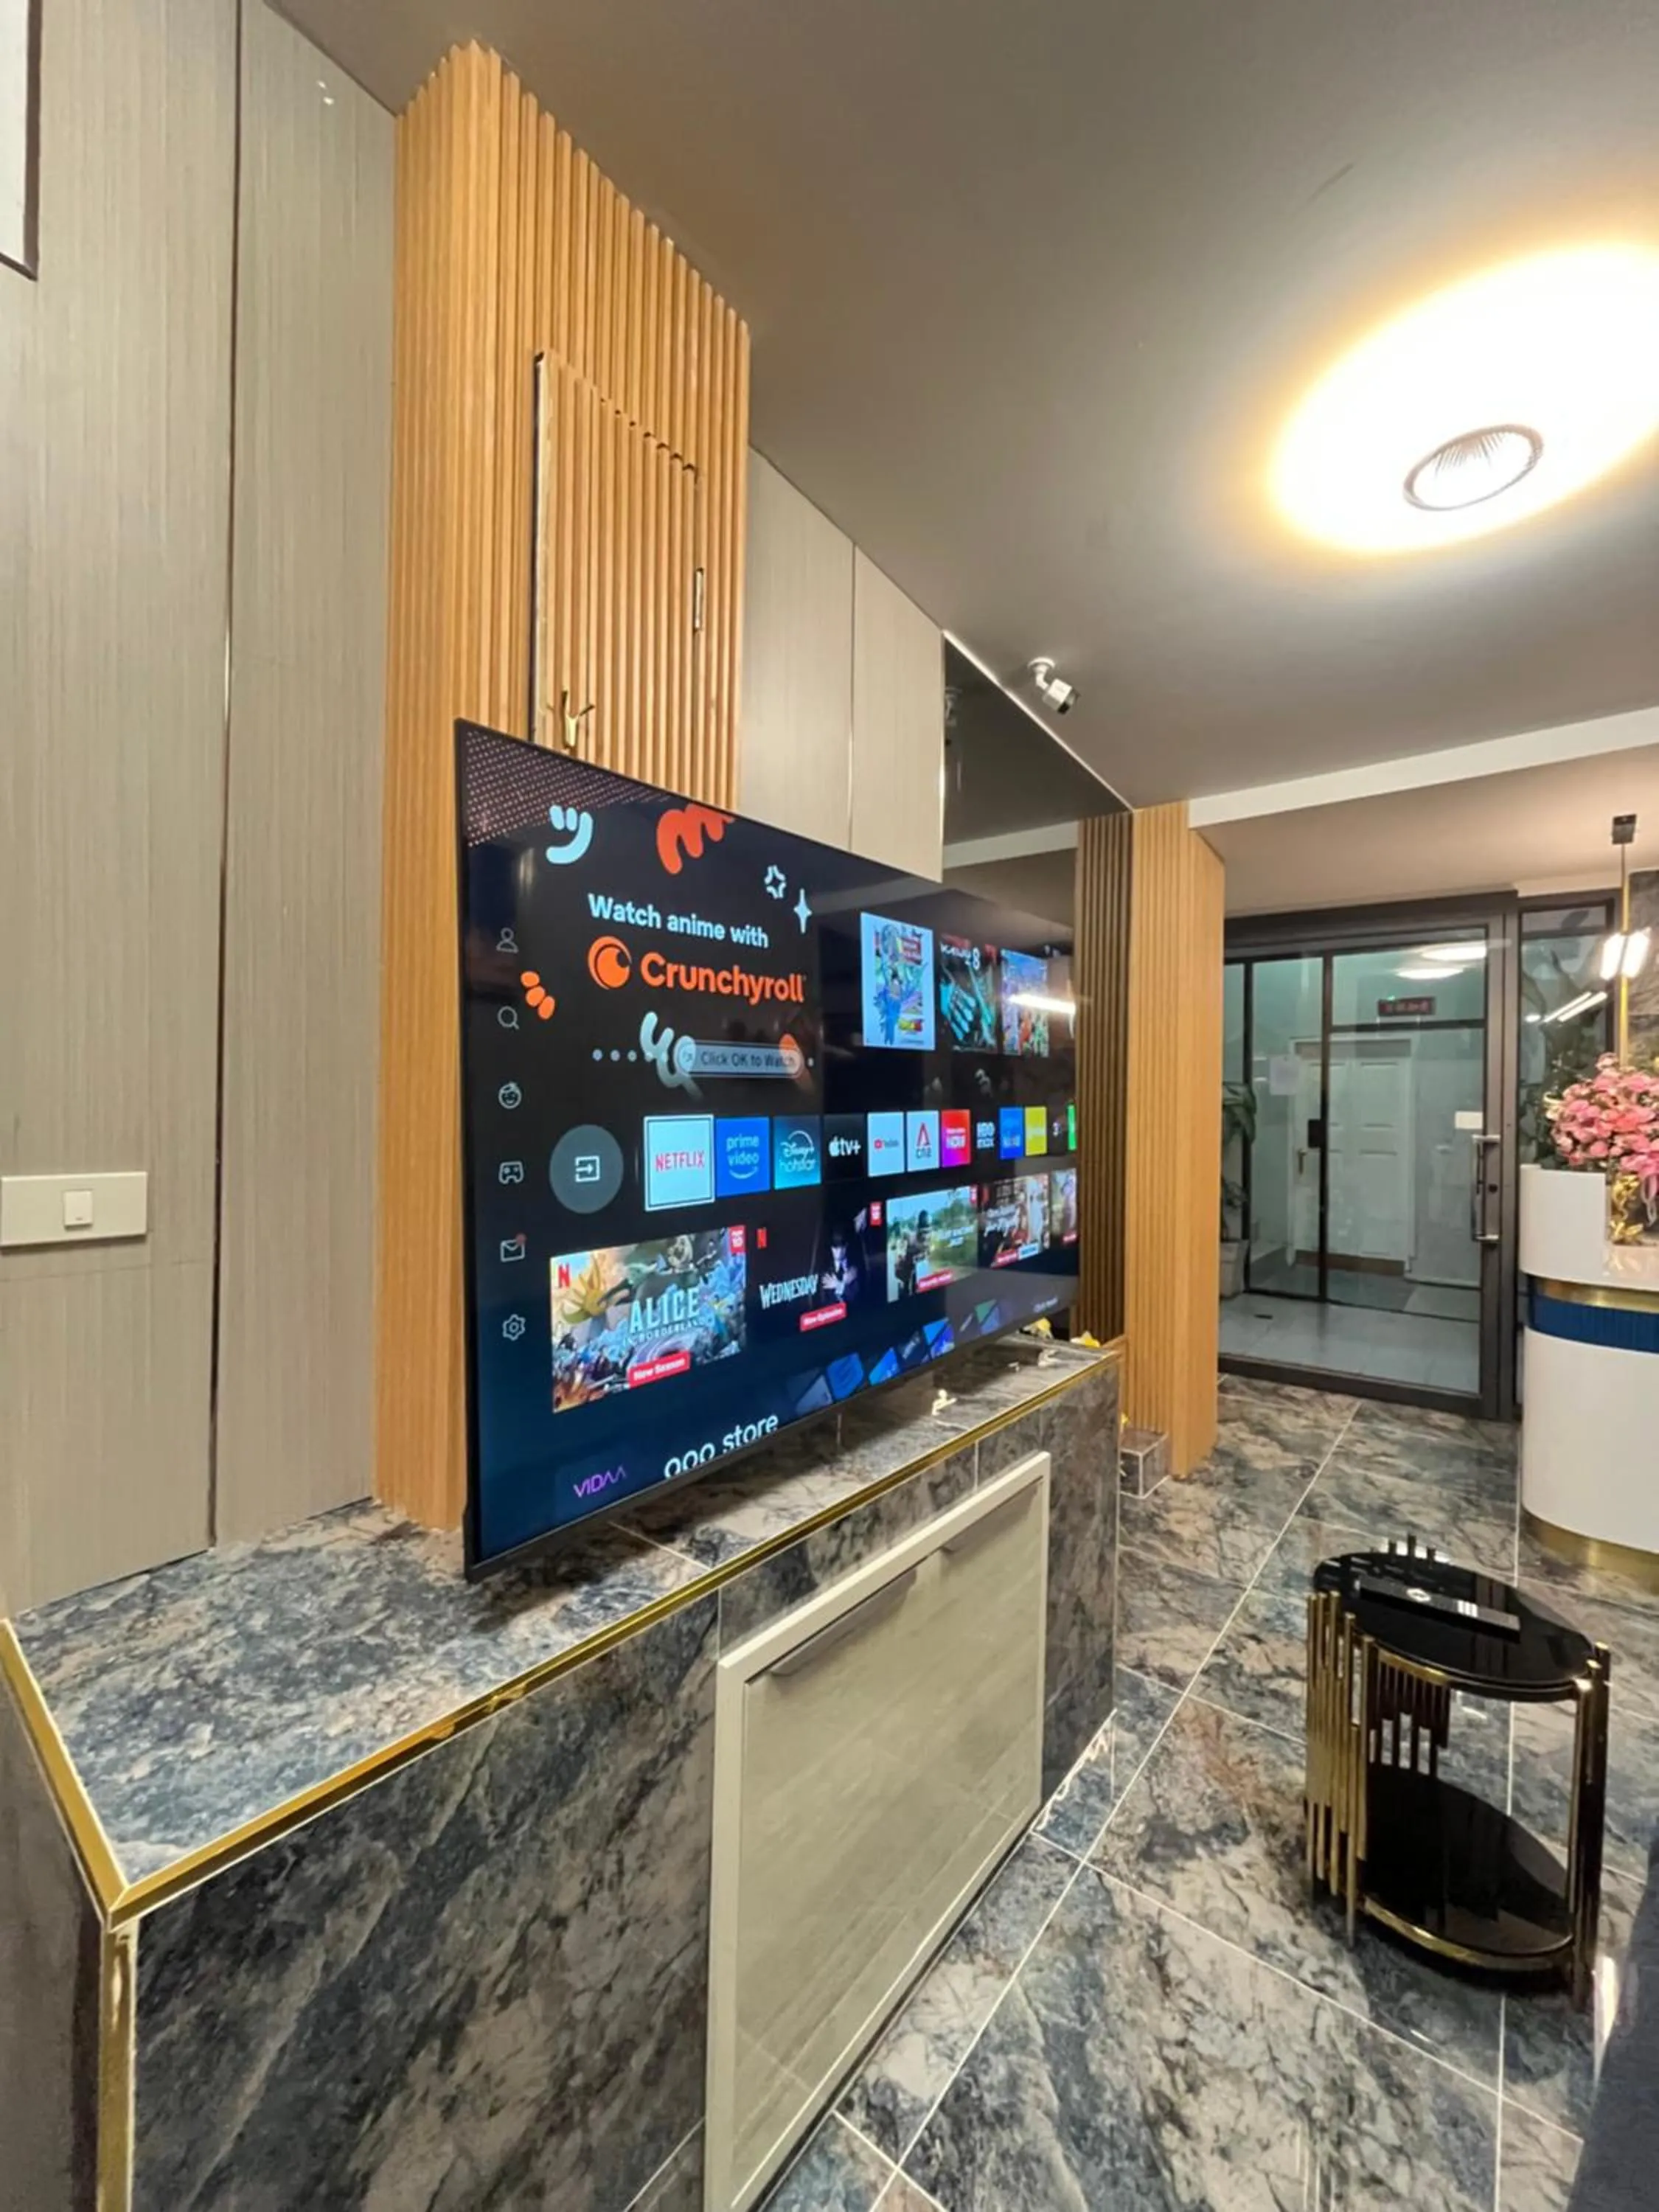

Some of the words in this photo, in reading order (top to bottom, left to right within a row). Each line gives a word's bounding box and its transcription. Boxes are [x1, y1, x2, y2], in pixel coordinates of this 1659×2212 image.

[588, 893, 661, 929] Watch
[667, 914, 726, 941] anime
[730, 925, 769, 948] with
[640, 952, 804, 1005] Crunchyroll
[700, 1051, 728, 1066] Click
[731, 1053, 748, 1066] OK
[751, 1054, 762, 1067] to
[726, 1133, 759, 1151] prime
[655, 1150, 705, 1174] NETFLIX
[727, 1152, 759, 1166] video
[558, 1263, 570, 1289] N
[759, 1273, 818, 1310] WEDNESDAY
[630, 1287, 700, 1334] ALICE
[722, 1413, 779, 1453] store
